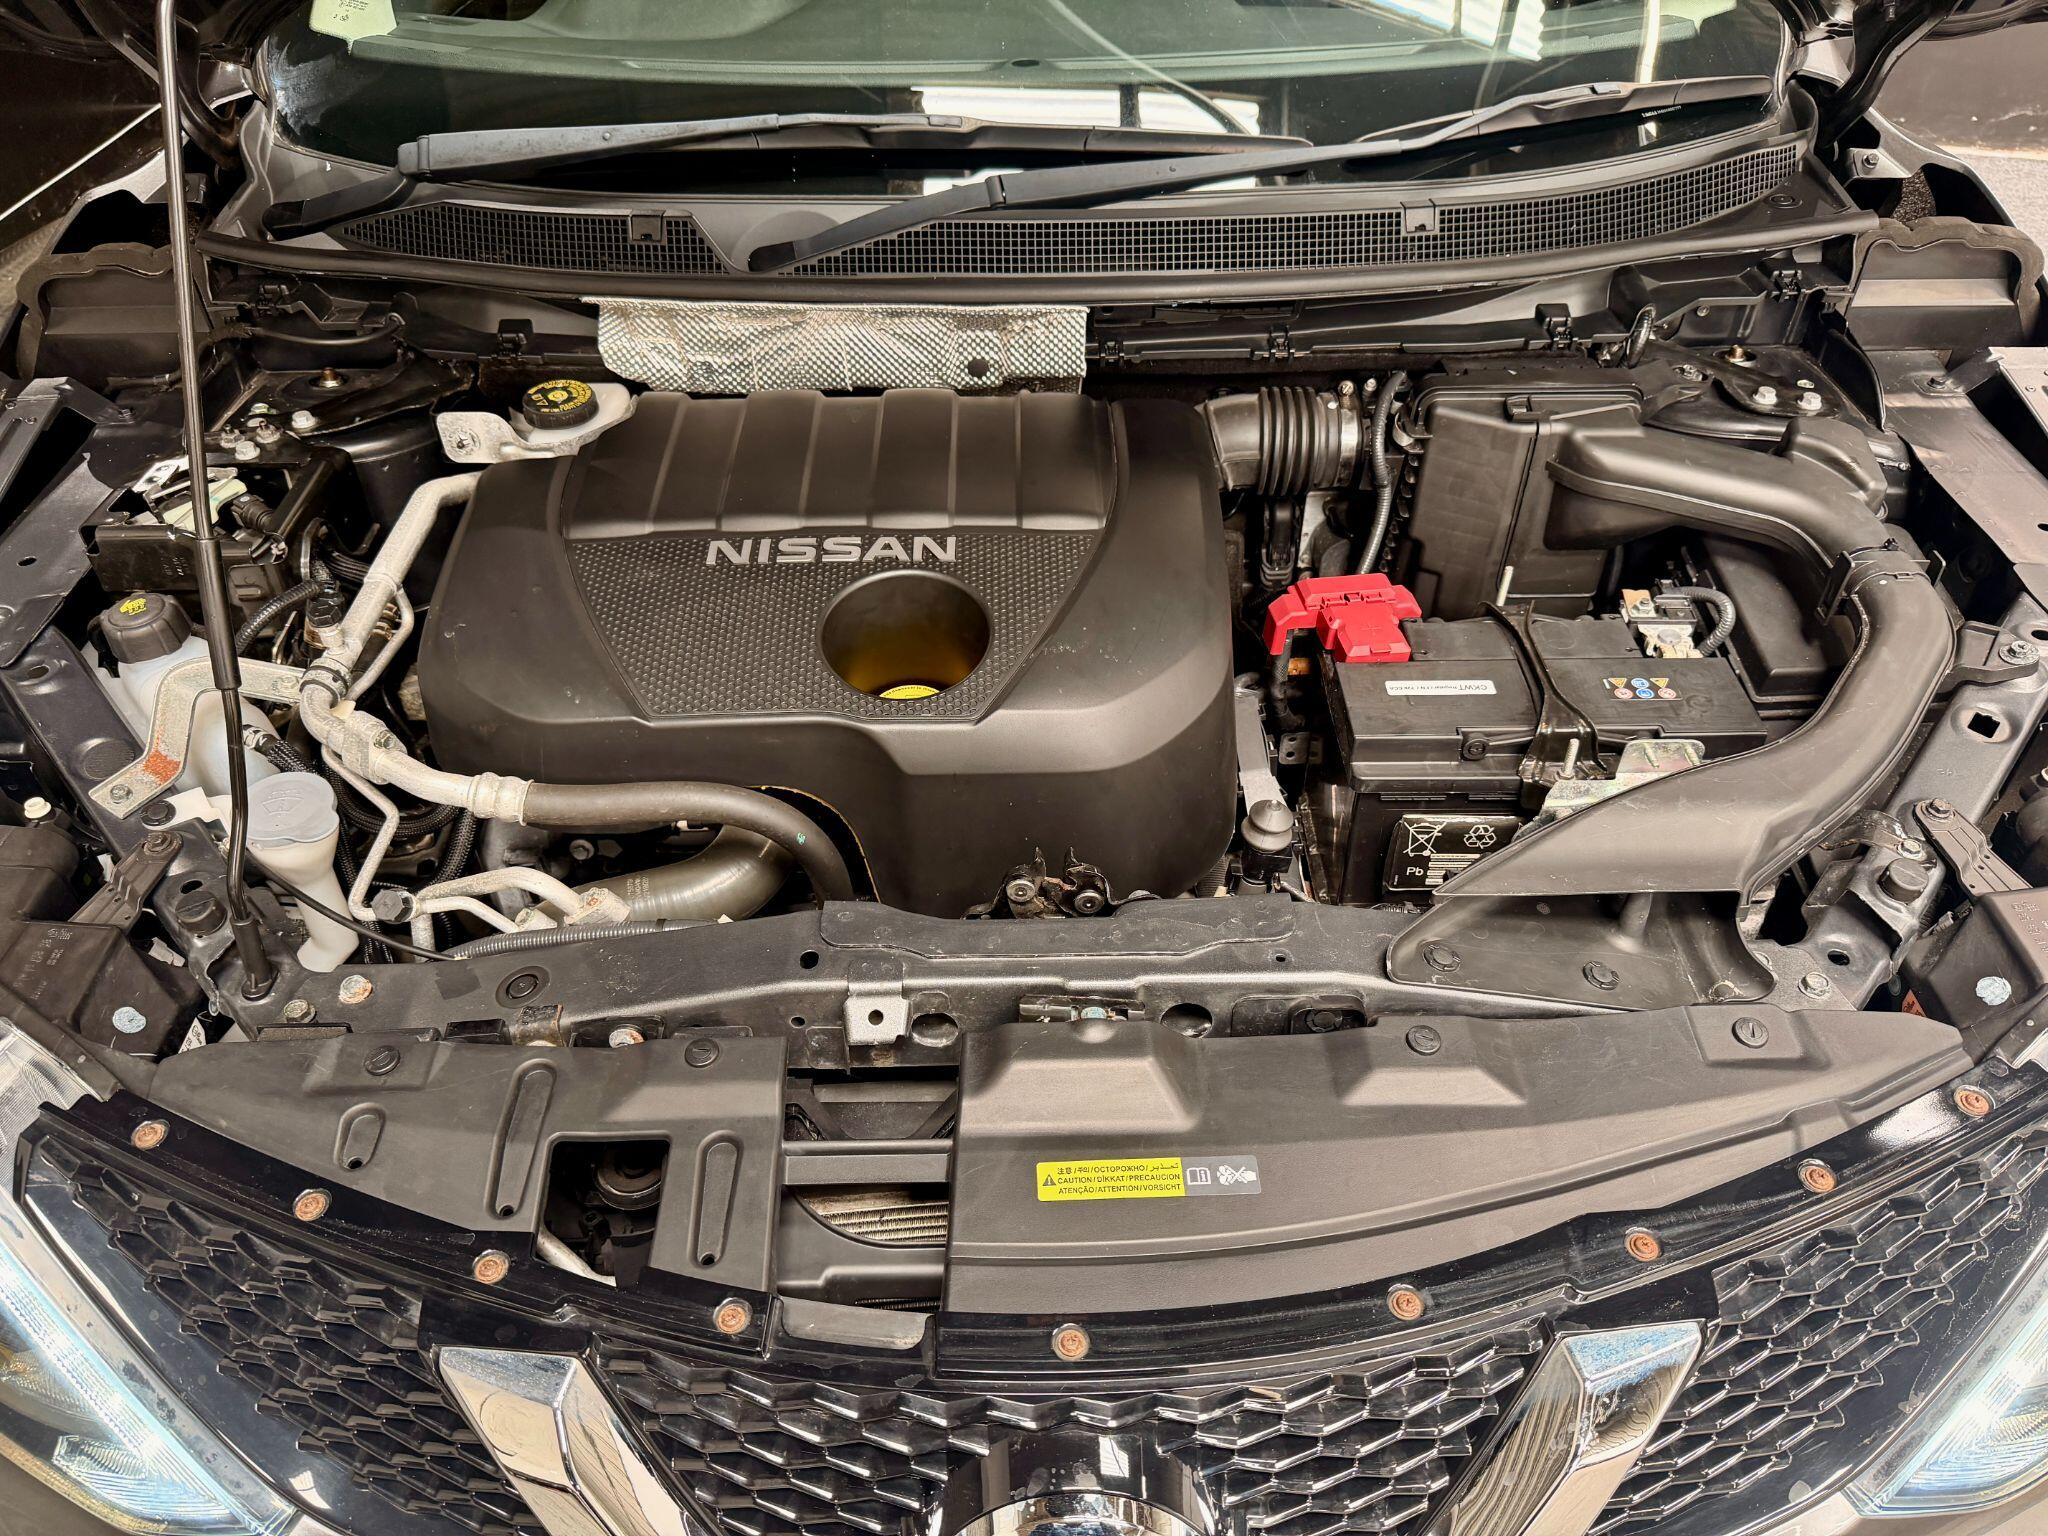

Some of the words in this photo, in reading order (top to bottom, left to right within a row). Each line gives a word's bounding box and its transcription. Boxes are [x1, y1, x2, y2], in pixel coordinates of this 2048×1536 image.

[706, 536, 957, 565] NISSAN
[1406, 866, 1424, 876] Pb
[1057, 1167, 1073, 1175] 注意
[1057, 1176, 1091, 1184] CAUTION
